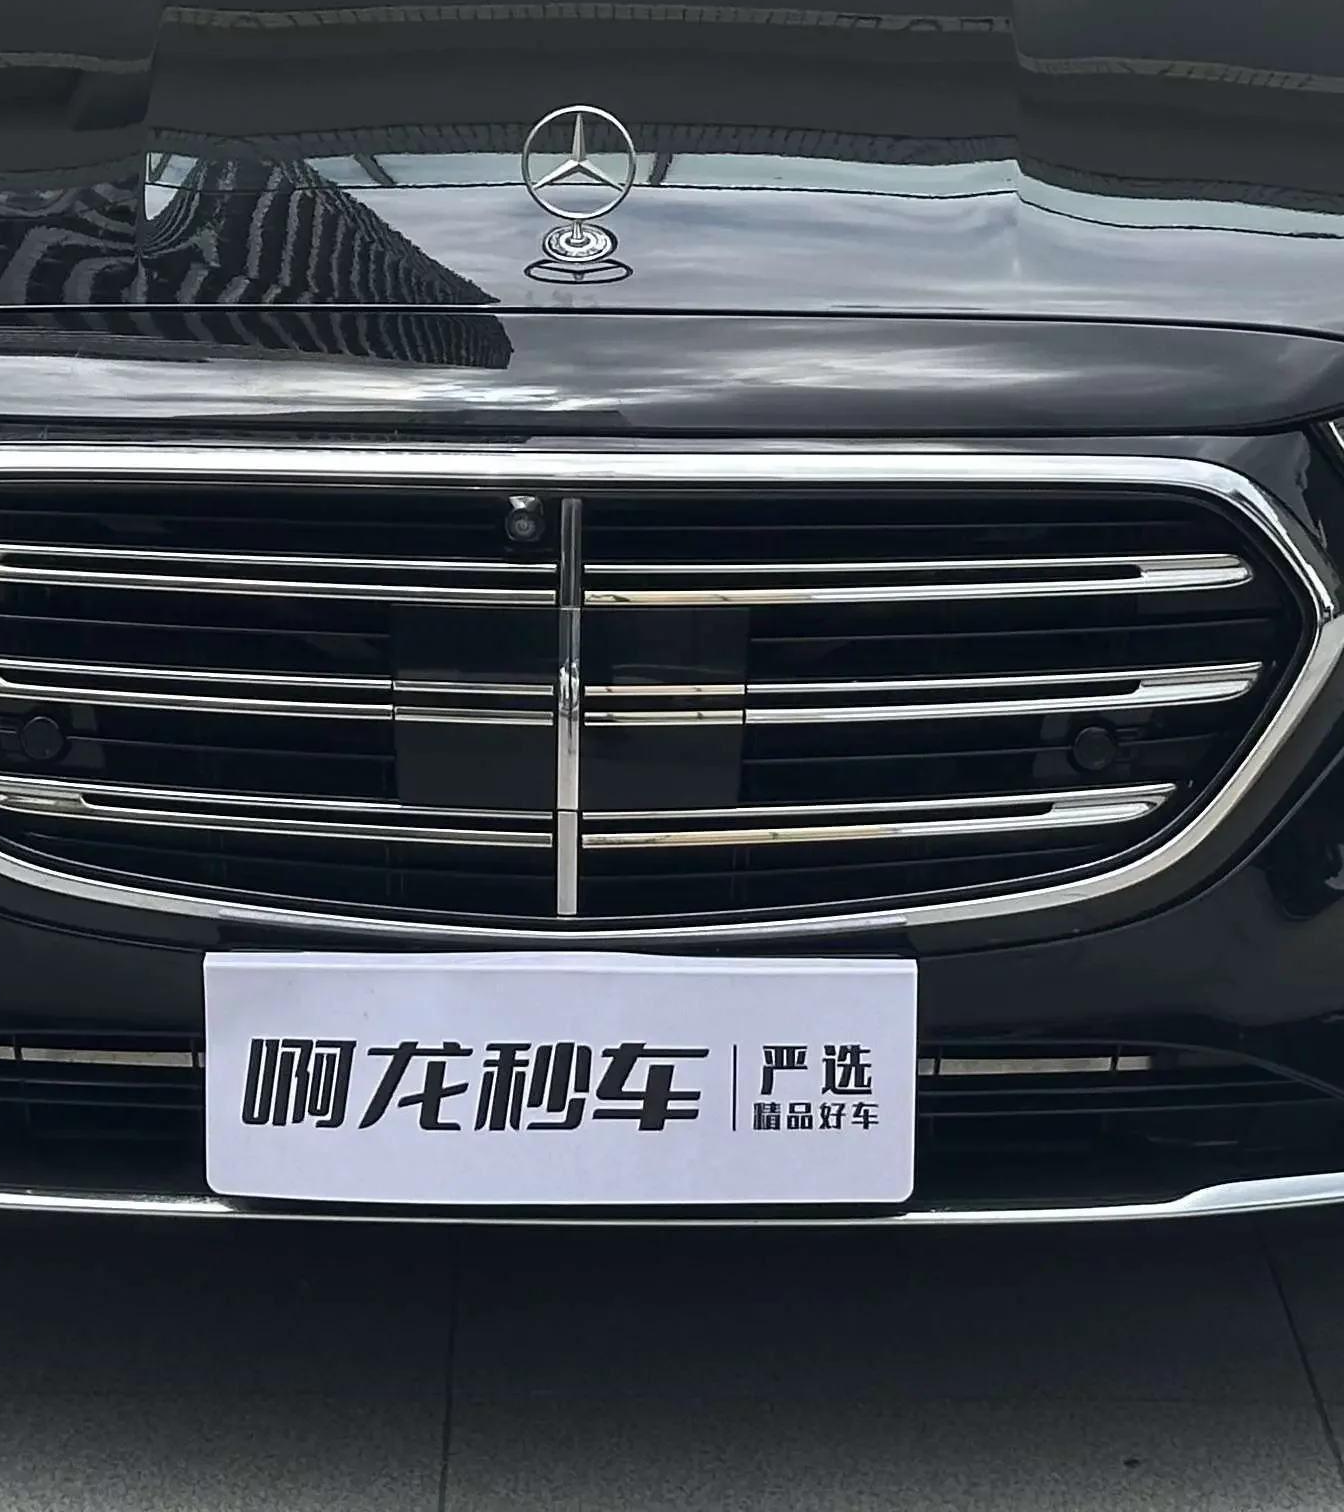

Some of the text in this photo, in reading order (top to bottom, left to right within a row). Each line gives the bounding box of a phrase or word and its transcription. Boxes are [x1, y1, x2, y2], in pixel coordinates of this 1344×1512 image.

[242, 1039, 709, 1131] 啊龙秒车
[760, 1044, 873, 1096] 严选
[753, 1101, 879, 1131] 精品好车
